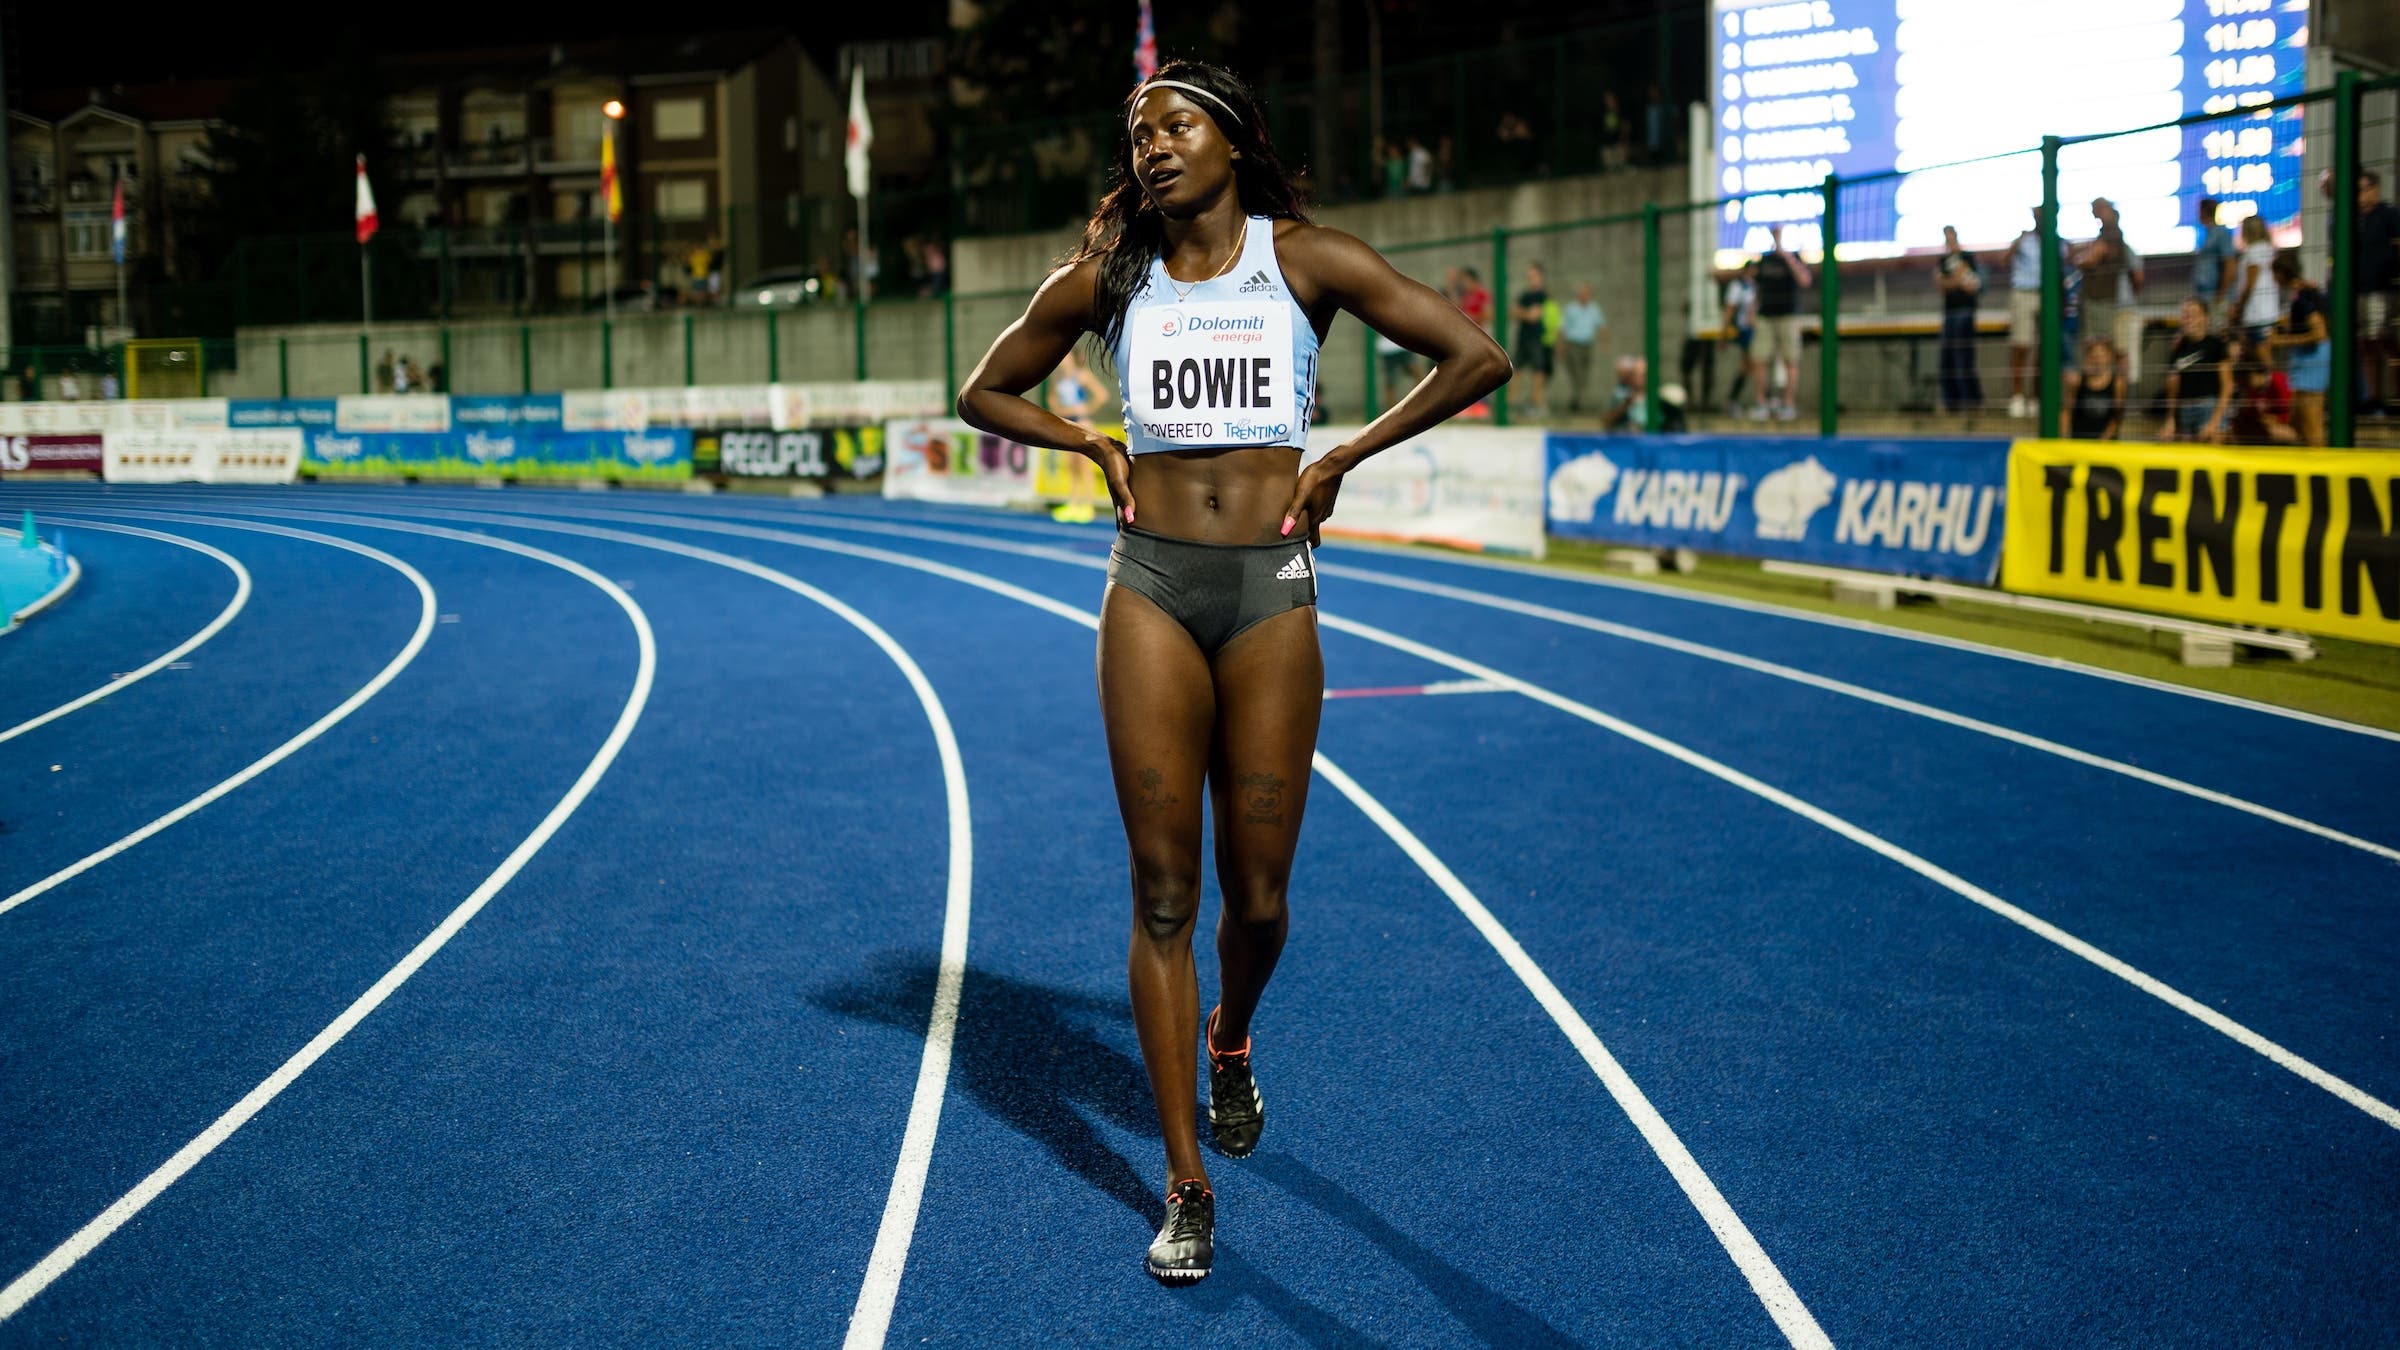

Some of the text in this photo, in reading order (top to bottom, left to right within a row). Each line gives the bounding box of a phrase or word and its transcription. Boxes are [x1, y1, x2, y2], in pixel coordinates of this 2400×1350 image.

[1239, 282, 1278, 293] adidas
[1188, 315, 1265, 331] Dolomiti
[1212, 332, 1263, 345] energia
[1152, 357, 1271, 410] BOWIE
[1613, 469, 1742, 534] KARHU
[1834, 478, 1997, 557] KARHU
[2043, 463, 2400, 622] TRENTIN
[1276, 569, 1310, 580] adidas
